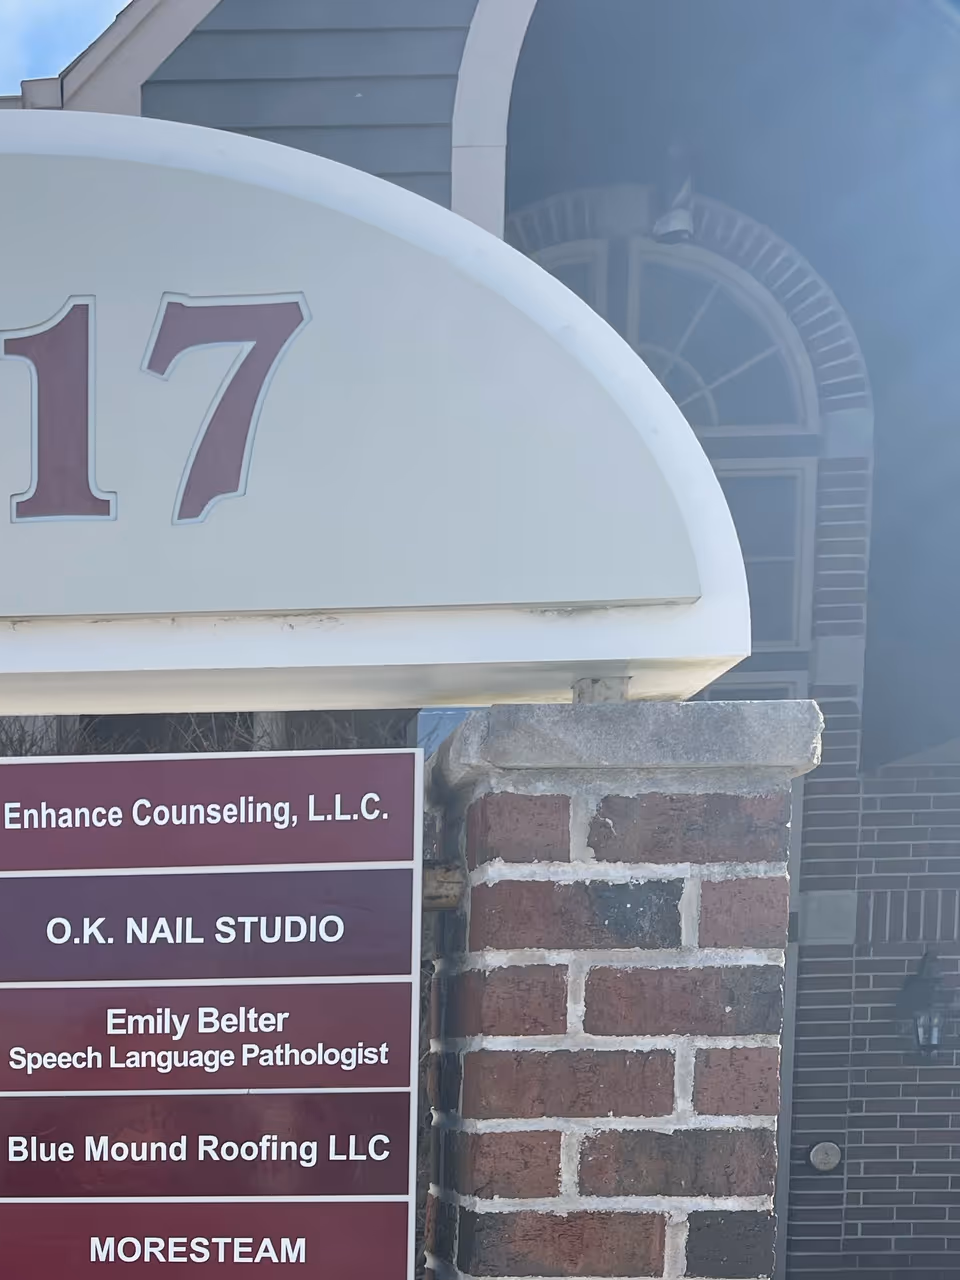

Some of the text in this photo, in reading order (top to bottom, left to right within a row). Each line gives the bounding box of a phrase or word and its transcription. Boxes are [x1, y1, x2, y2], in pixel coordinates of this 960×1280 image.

[5, 793, 387, 829] Enhance Counseling, L.L.C.
[47, 916, 344, 944] O.K. NAIL STUDIO
[107, 1007, 289, 1040] Emily Belter
[9, 1042, 388, 1074] Speech Language Pathologist
[9, 1135, 389, 1167] Blue Mound Roofing LLC
[91, 1237, 305, 1262] MORESTEAM
